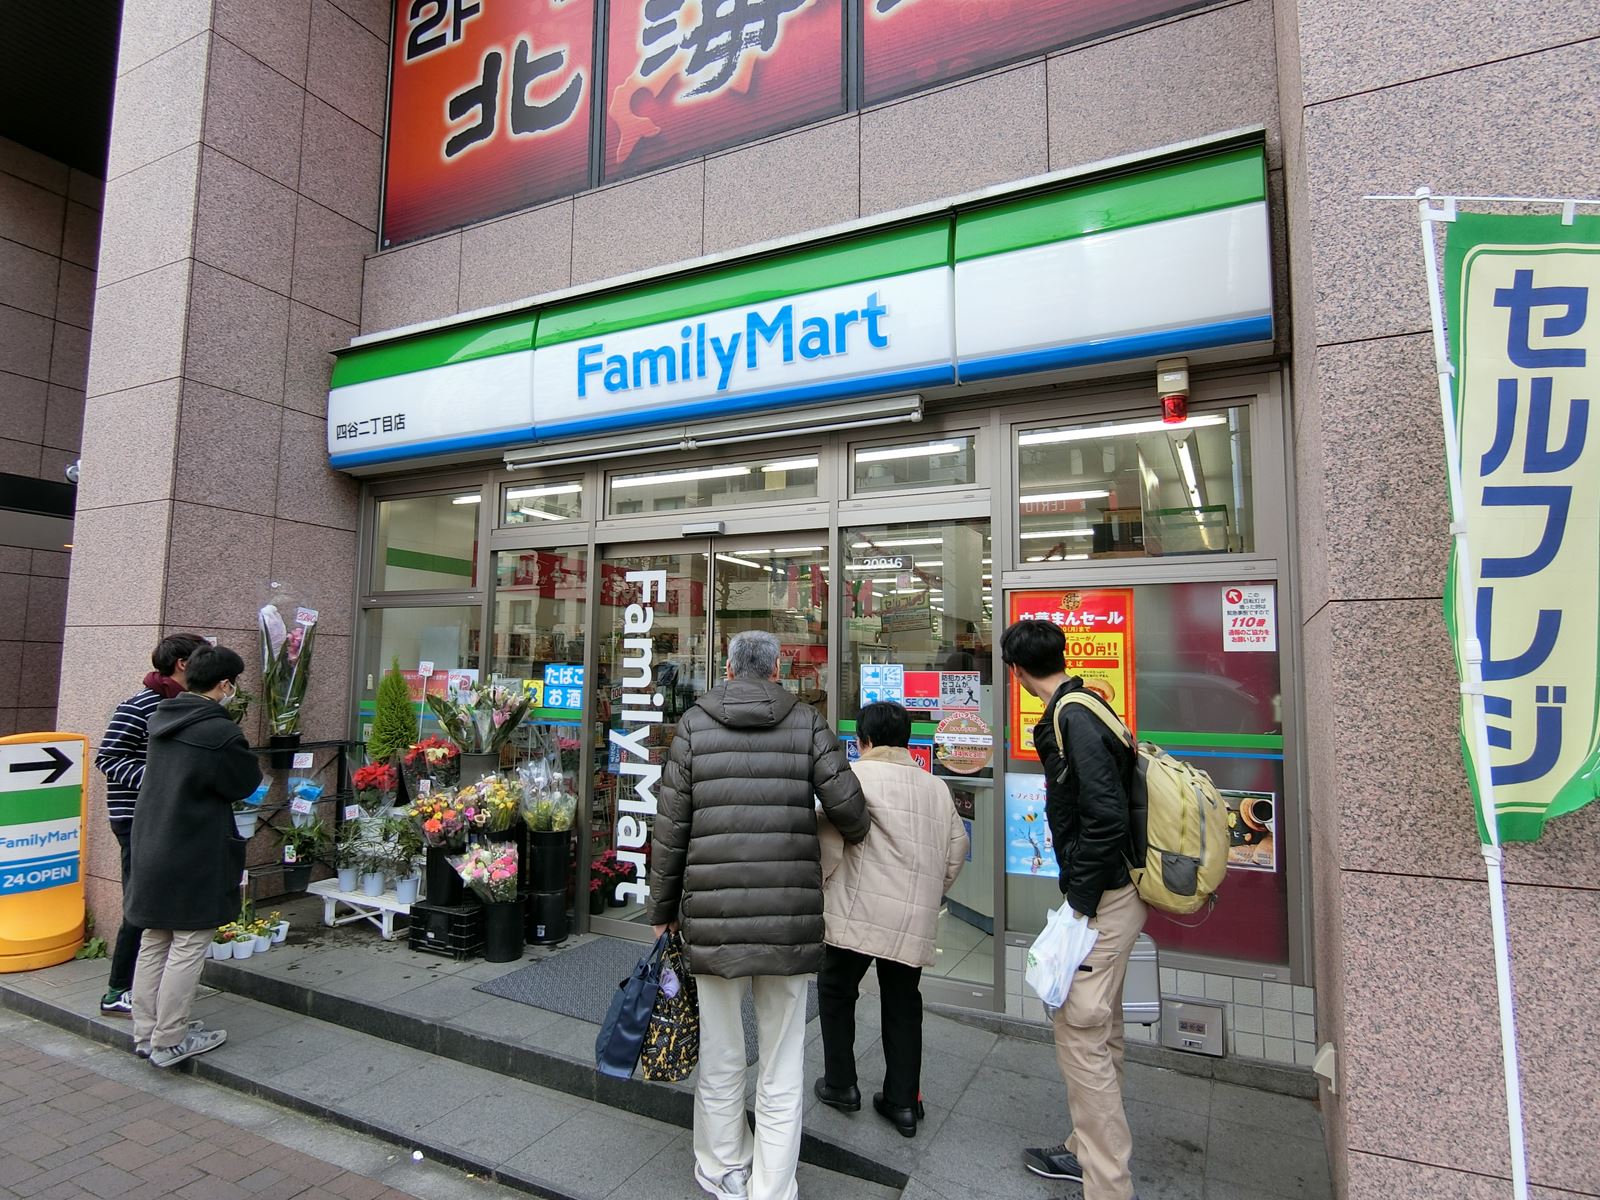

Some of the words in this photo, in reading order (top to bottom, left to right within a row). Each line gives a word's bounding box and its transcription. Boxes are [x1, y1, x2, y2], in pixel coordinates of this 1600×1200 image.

[407, 0, 479, 59] 2F
[445, 0, 908, 158] 北海
[577, 291, 888, 399] FamilyMart
[336, 413, 405, 440] 四谷二丁目店
[1476, 268, 1590, 787] セルフレジ
[1232, 617, 1266, 627] 110番
[545, 667, 584, 686] たばこ
[941, 674, 979, 682] 防犯カメラで
[941, 681, 969, 689] セコムが
[548, 689, 581, 708] お酒
[941, 687, 964, 695] 監視中
[905, 698, 938, 708] SECOM
[609, 570, 666, 905] FamilyMart
[0, 828, 78, 848] FamilyMart
[3, 873, 26, 888] 24
[26, 865, 72, 884] OPEN
